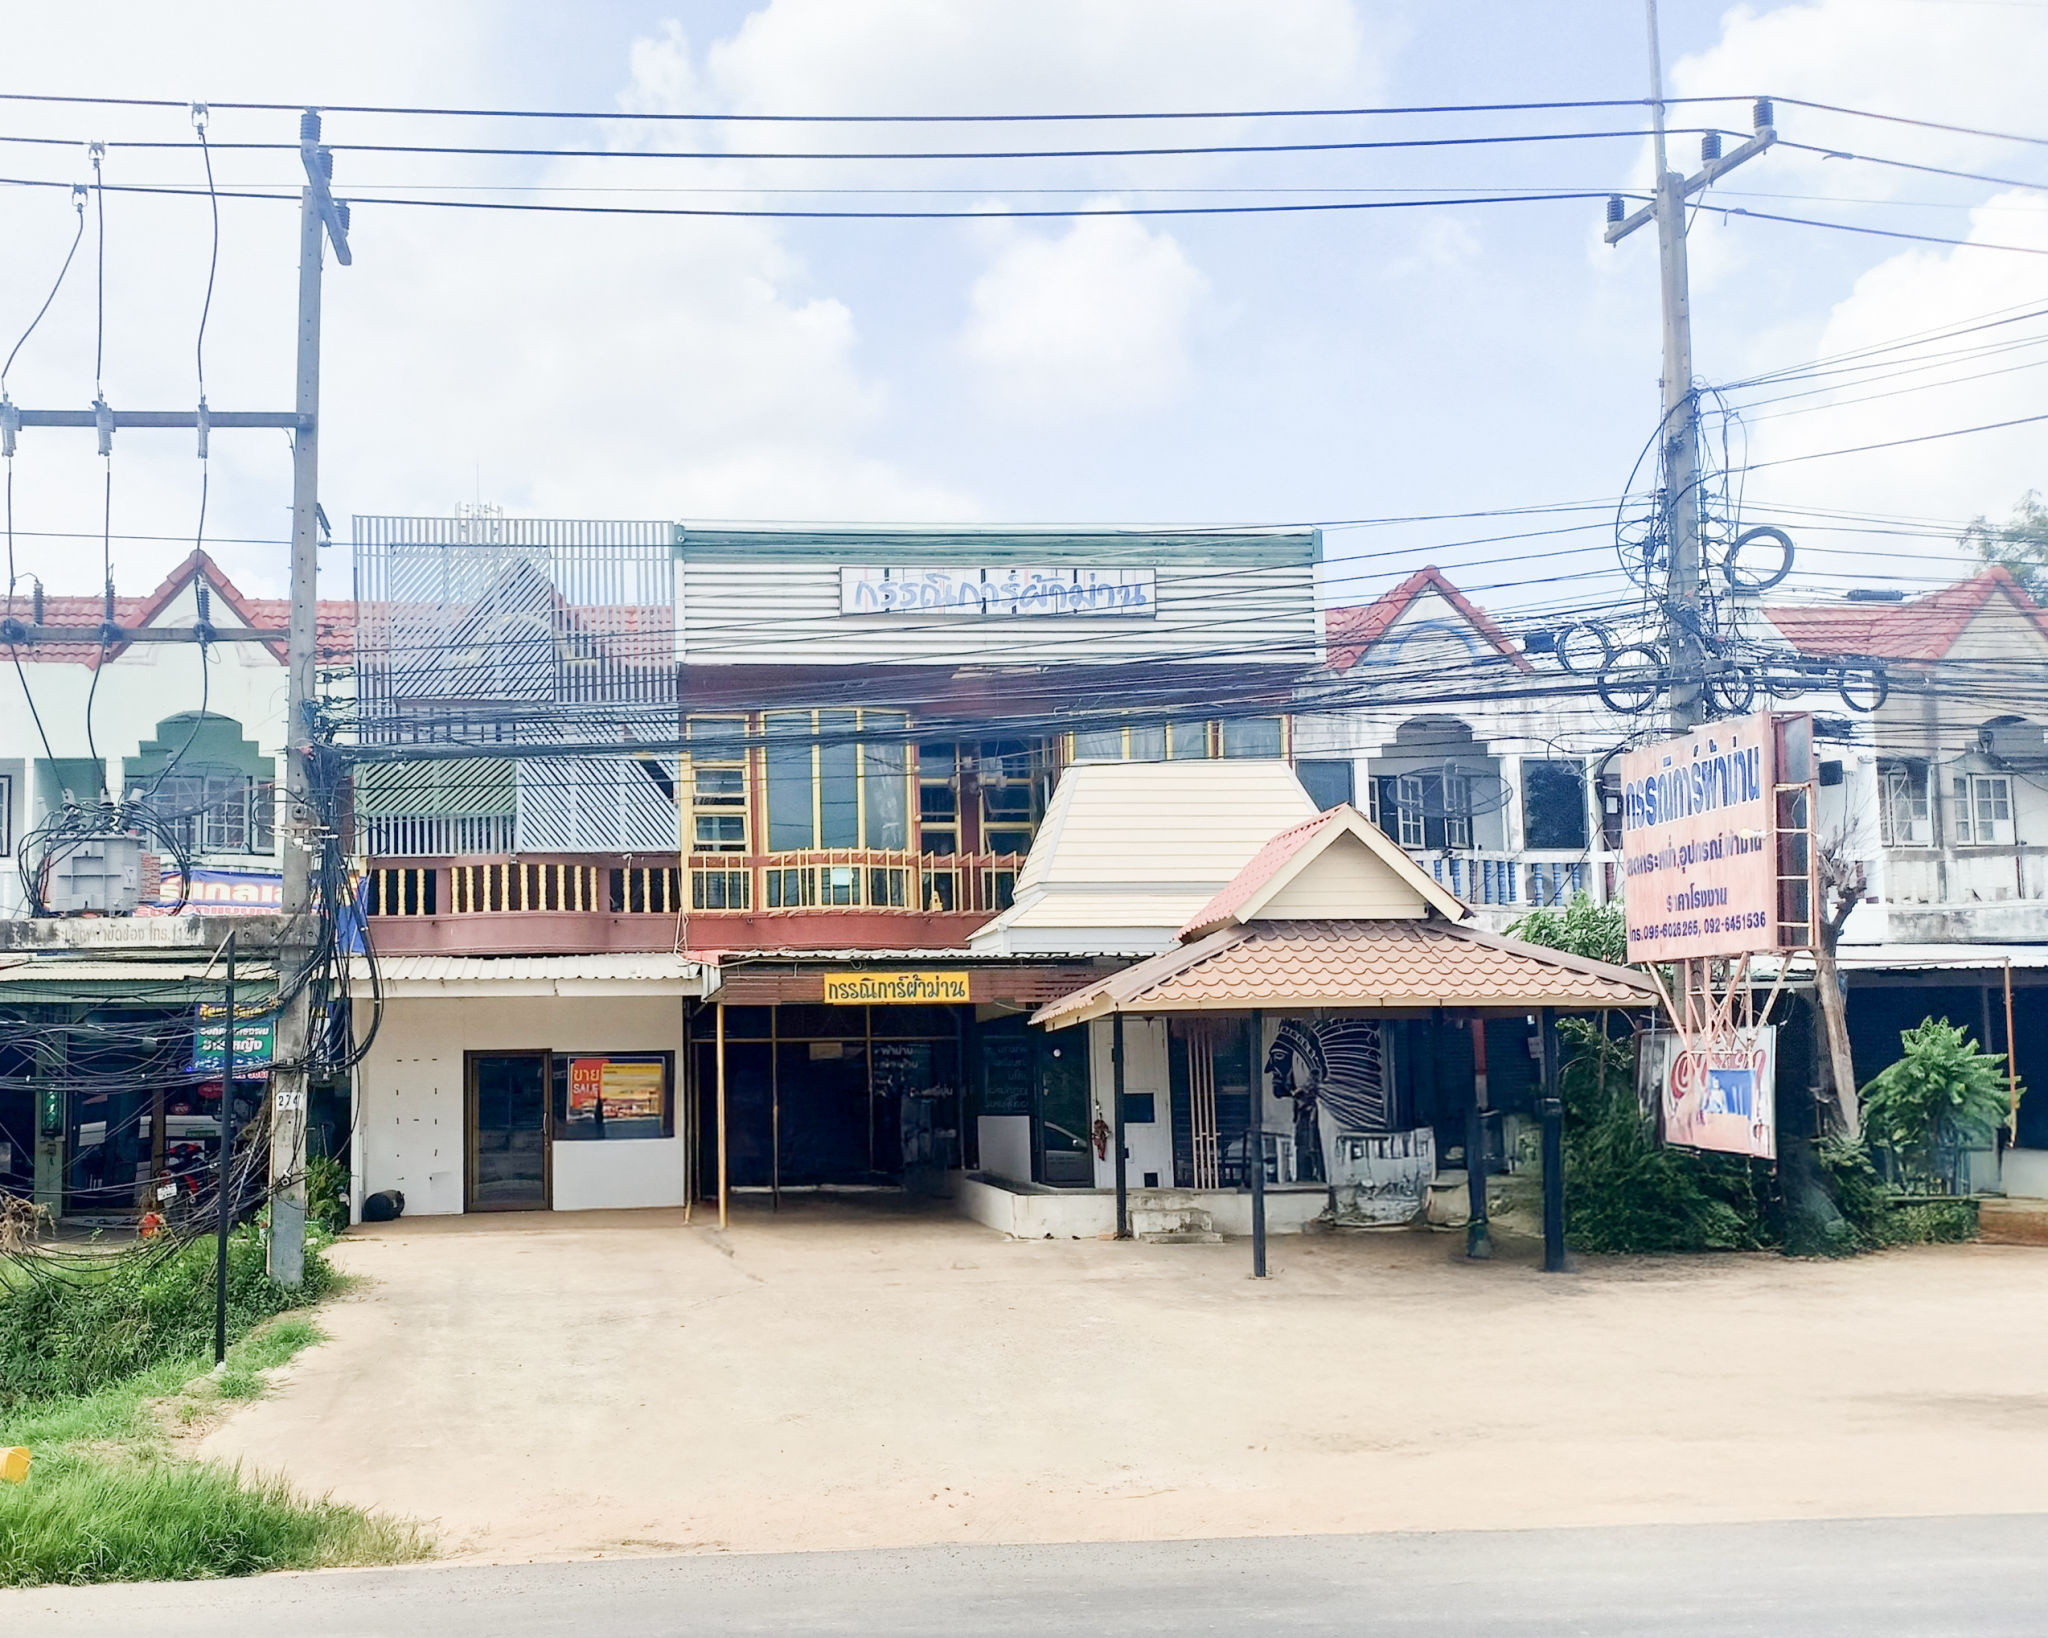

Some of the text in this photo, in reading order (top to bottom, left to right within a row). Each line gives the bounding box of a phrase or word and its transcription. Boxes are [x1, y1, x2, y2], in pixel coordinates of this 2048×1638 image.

[1667, 883, 1727, 912] ราคาโรงงาน
[1704, 911, 1766, 934] 092-6451536
[829, 974, 965, 999] กรรณิการ์ผ้าม่าน
[573, 1069, 600, 1082] ขาย
[573, 1083, 599, 1095] SALE
